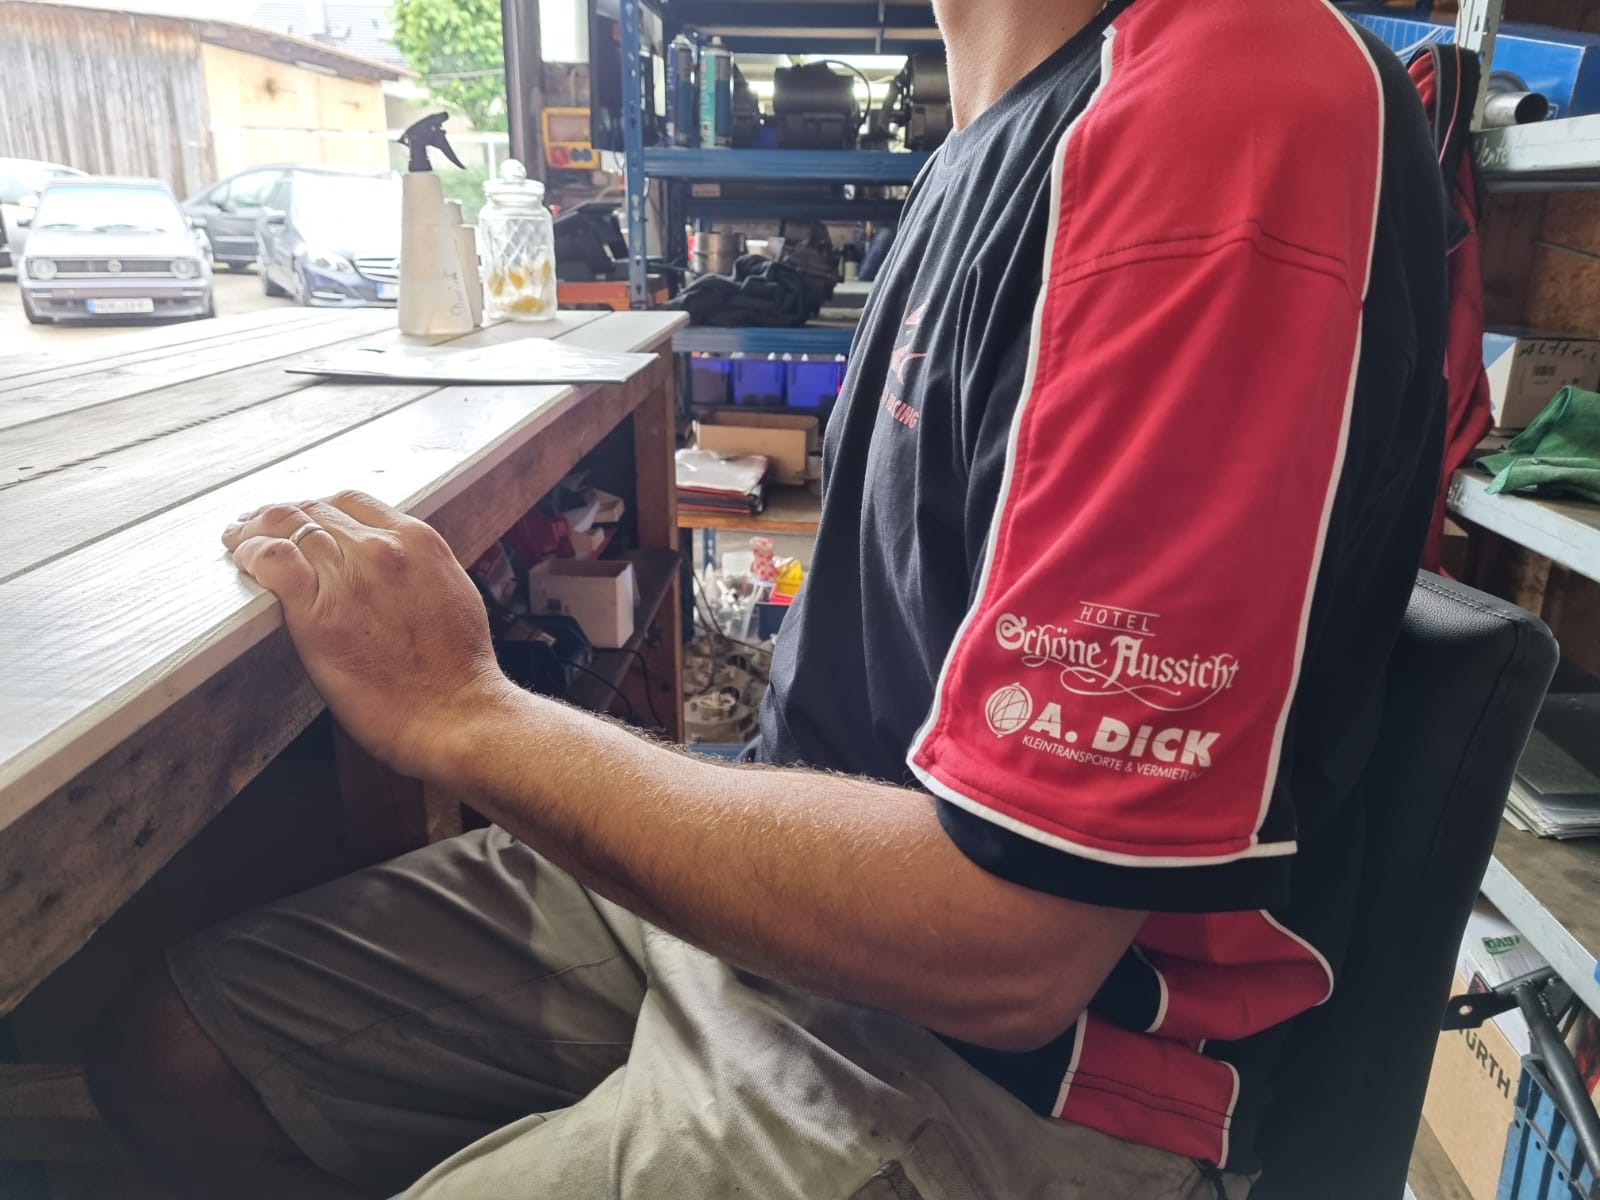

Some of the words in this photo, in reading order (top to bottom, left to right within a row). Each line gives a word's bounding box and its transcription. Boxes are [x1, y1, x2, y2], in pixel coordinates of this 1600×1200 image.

[995, 612, 1107, 668] Schöne
[1102, 634, 1240, 690] Aussicht
[1079, 605, 1150, 633] HOTEL
[1021, 733, 1123, 773] KLEINTRANSPORTE
[1124, 761, 1134, 774] &
[1028, 701, 1078, 744] A.
[1091, 715, 1222, 768] DICK
[1459, 1029, 1512, 1100] ÜRTH
